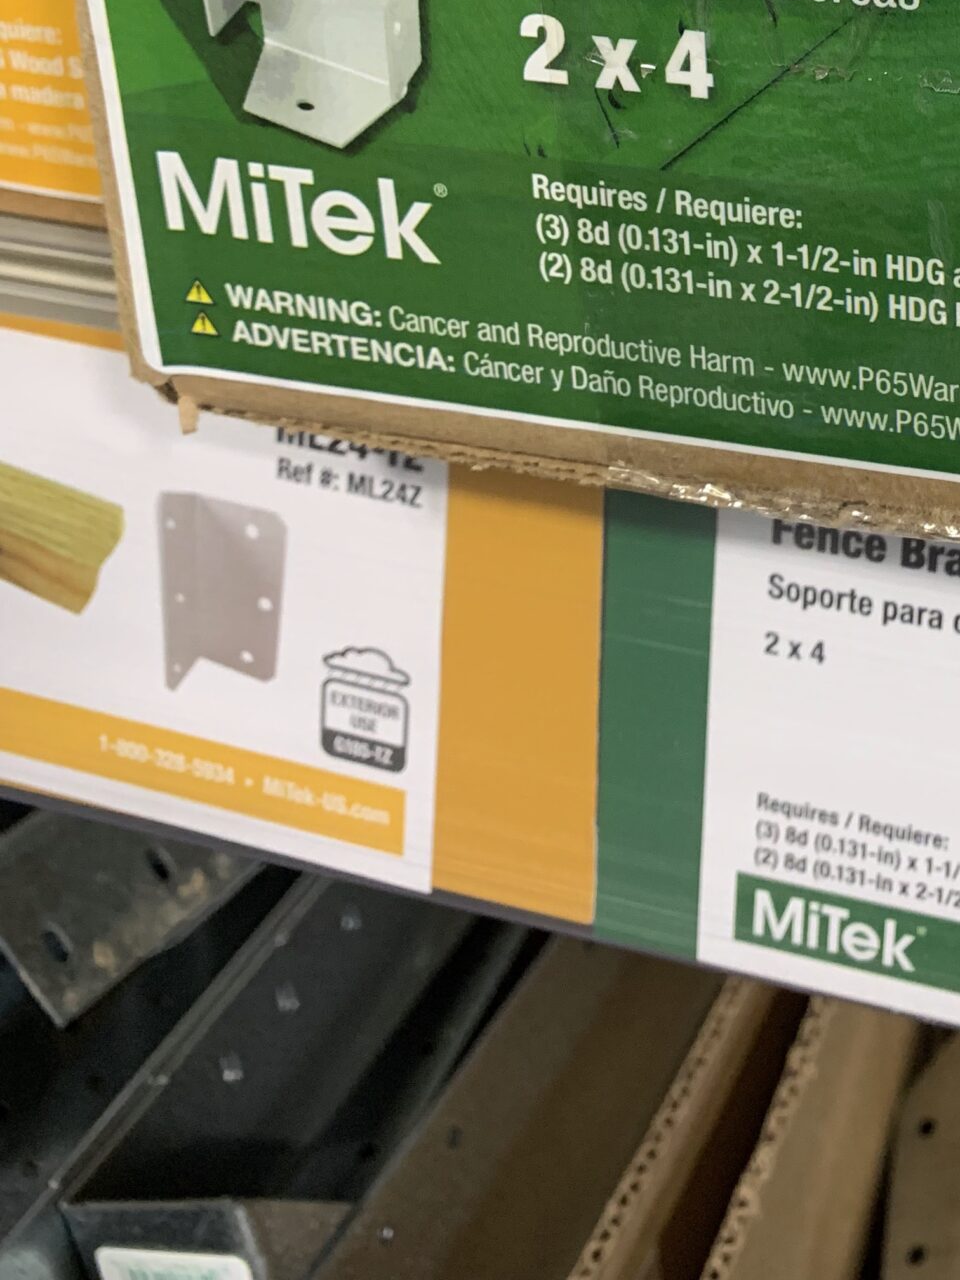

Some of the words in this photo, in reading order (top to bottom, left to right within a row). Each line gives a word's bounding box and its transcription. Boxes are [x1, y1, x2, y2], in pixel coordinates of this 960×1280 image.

[519, 13, 569, 85] 2
[591, 34, 641, 93] x
[664, 29, 714, 99] 4
[532, 173, 648, 213] Requires
[675, 193, 803, 231] Requiere:
[535, 212, 570, 247] (3)
[577, 218, 610, 248] 8d
[618, 221, 739, 266] (0.131-in)
[746, 242, 763, 265] x
[772, 239, 877, 279] 1-1/2-in
[886, 254, 945, 287] HDG
[538, 252, 573, 285] (2)
[579, 256, 613, 287] 8d
[621, 259, 732, 300] (0.131-in
[740, 280, 757, 304] x
[763, 276, 879, 322] 2-1/2-in)
[888, 293, 947, 326] HDG
[225, 283, 382, 328] WARNING:
[389, 305, 468, 341] Cancer
[477, 316, 520, 347] and
[528, 323, 681, 368] Reproductive
[690, 344, 755, 377] Harm
[233, 320, 456, 374] ADVERTENCIA:
[464, 351, 543, 386] Cáncer
[551, 368, 565, 392] y
[571, 367, 631, 398] Daño
[638, 375, 795, 420] Reproductivo
[277, 455, 314, 484] Ref
[346, 472, 424, 509] ML24Z
[771, 518, 888, 564] Fence
[767, 572, 873, 616] Soporte
[882, 599, 944, 631] para
[763, 631, 781, 657] 2
[787, 641, 803, 662] x
[810, 639, 826, 664] 4
[755, 819, 780, 845] (3)
[785, 825, 809, 848] 8d
[814, 832, 902, 873] (0.131-in)
[908, 856, 918, 871] x
[757, 792, 839, 827] Requires
[858, 813, 951, 851] Requiere:
[754, 846, 779, 871] (2)
[783, 852, 807, 874] 8d
[812, 859, 893, 892] (0.131-in
[900, 881, 910, 896] x
[752, 887, 916, 973] MiTek
